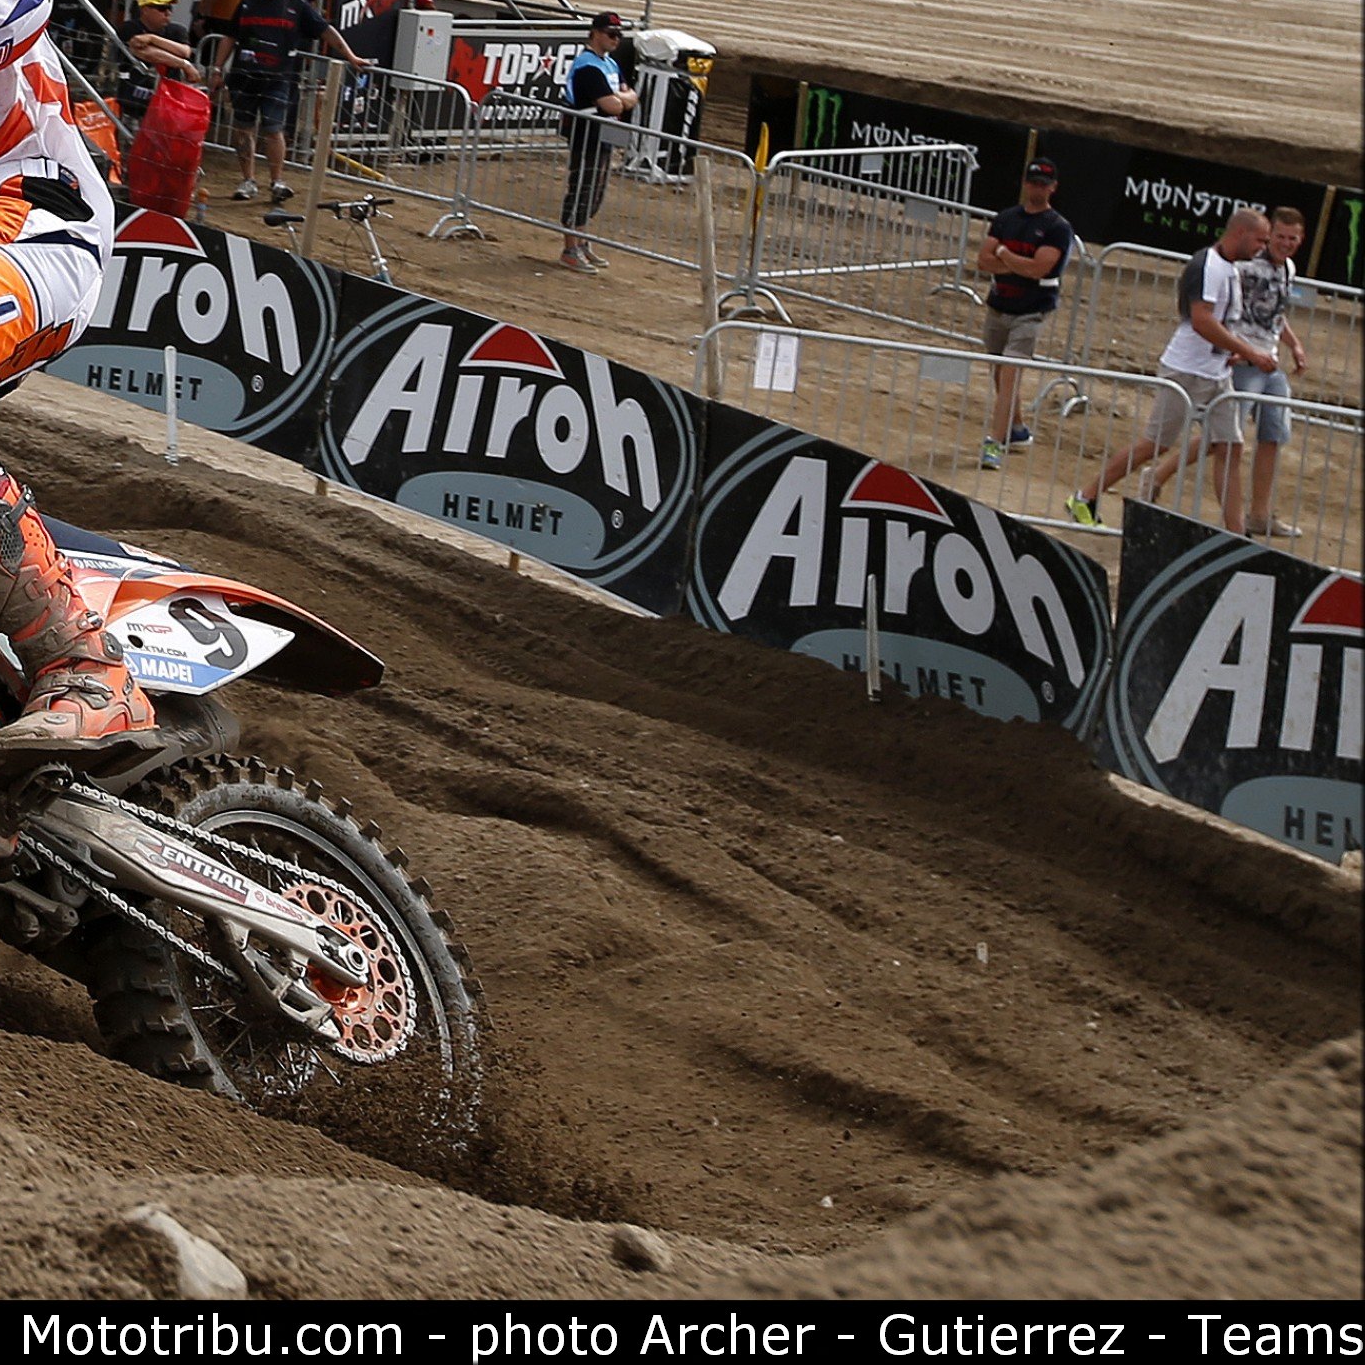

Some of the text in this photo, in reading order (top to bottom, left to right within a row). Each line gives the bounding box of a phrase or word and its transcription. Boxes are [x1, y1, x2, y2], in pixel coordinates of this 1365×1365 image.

[483, 43, 540, 85] TOP
[87, 363, 204, 403] HELMET
[442, 492, 564, 537] HELMET
[168, 596, 249, 671] 9
[140, 657, 194, 684] MAPEI
[265, 897, 304, 921] brembo
